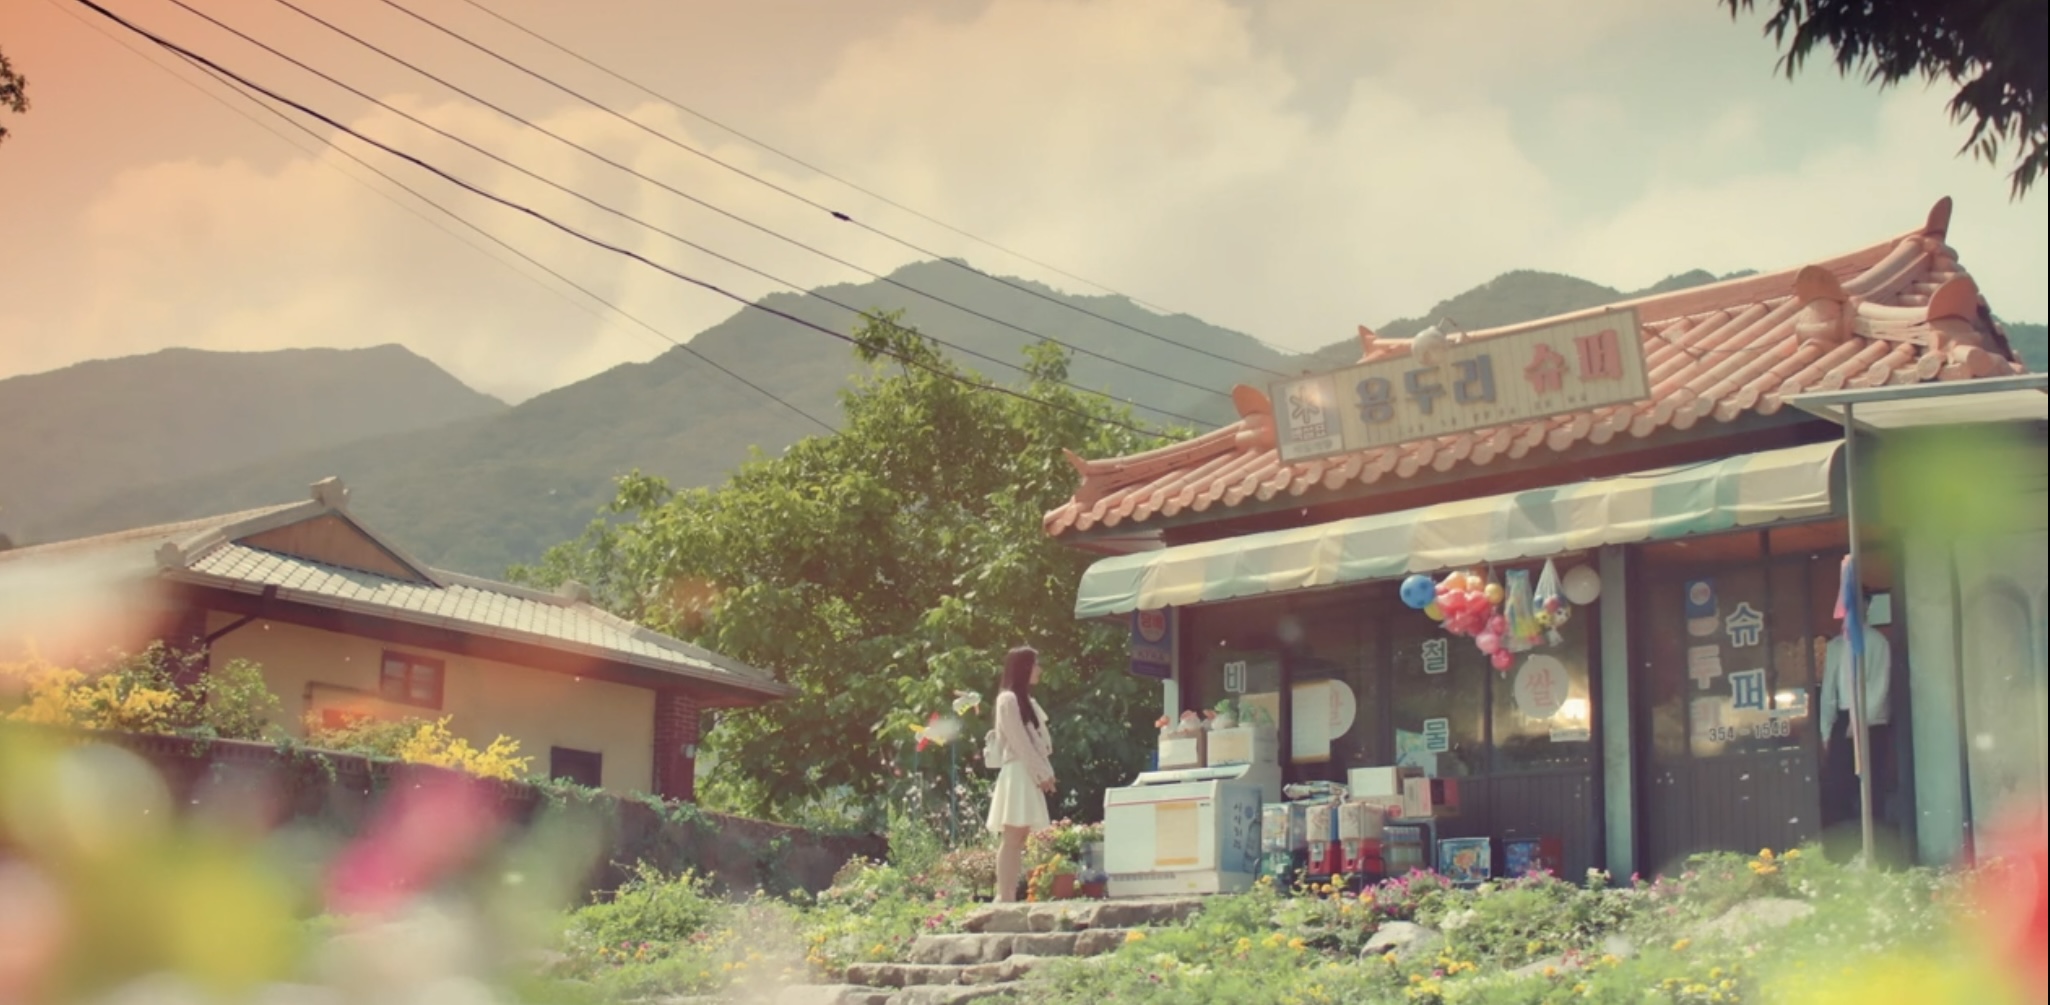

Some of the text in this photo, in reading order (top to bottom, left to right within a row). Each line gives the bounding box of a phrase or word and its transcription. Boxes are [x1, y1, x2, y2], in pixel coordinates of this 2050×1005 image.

[1355, 355, 1497, 424] 용두리
[1525, 329, 1623, 393] 슈퍼
[1224, 661, 1246, 693] 비
[1422, 638, 1448, 752] 철물
[1525, 668, 1556, 707] 쌀
[1726, 602, 1766, 710] 슈퍼
